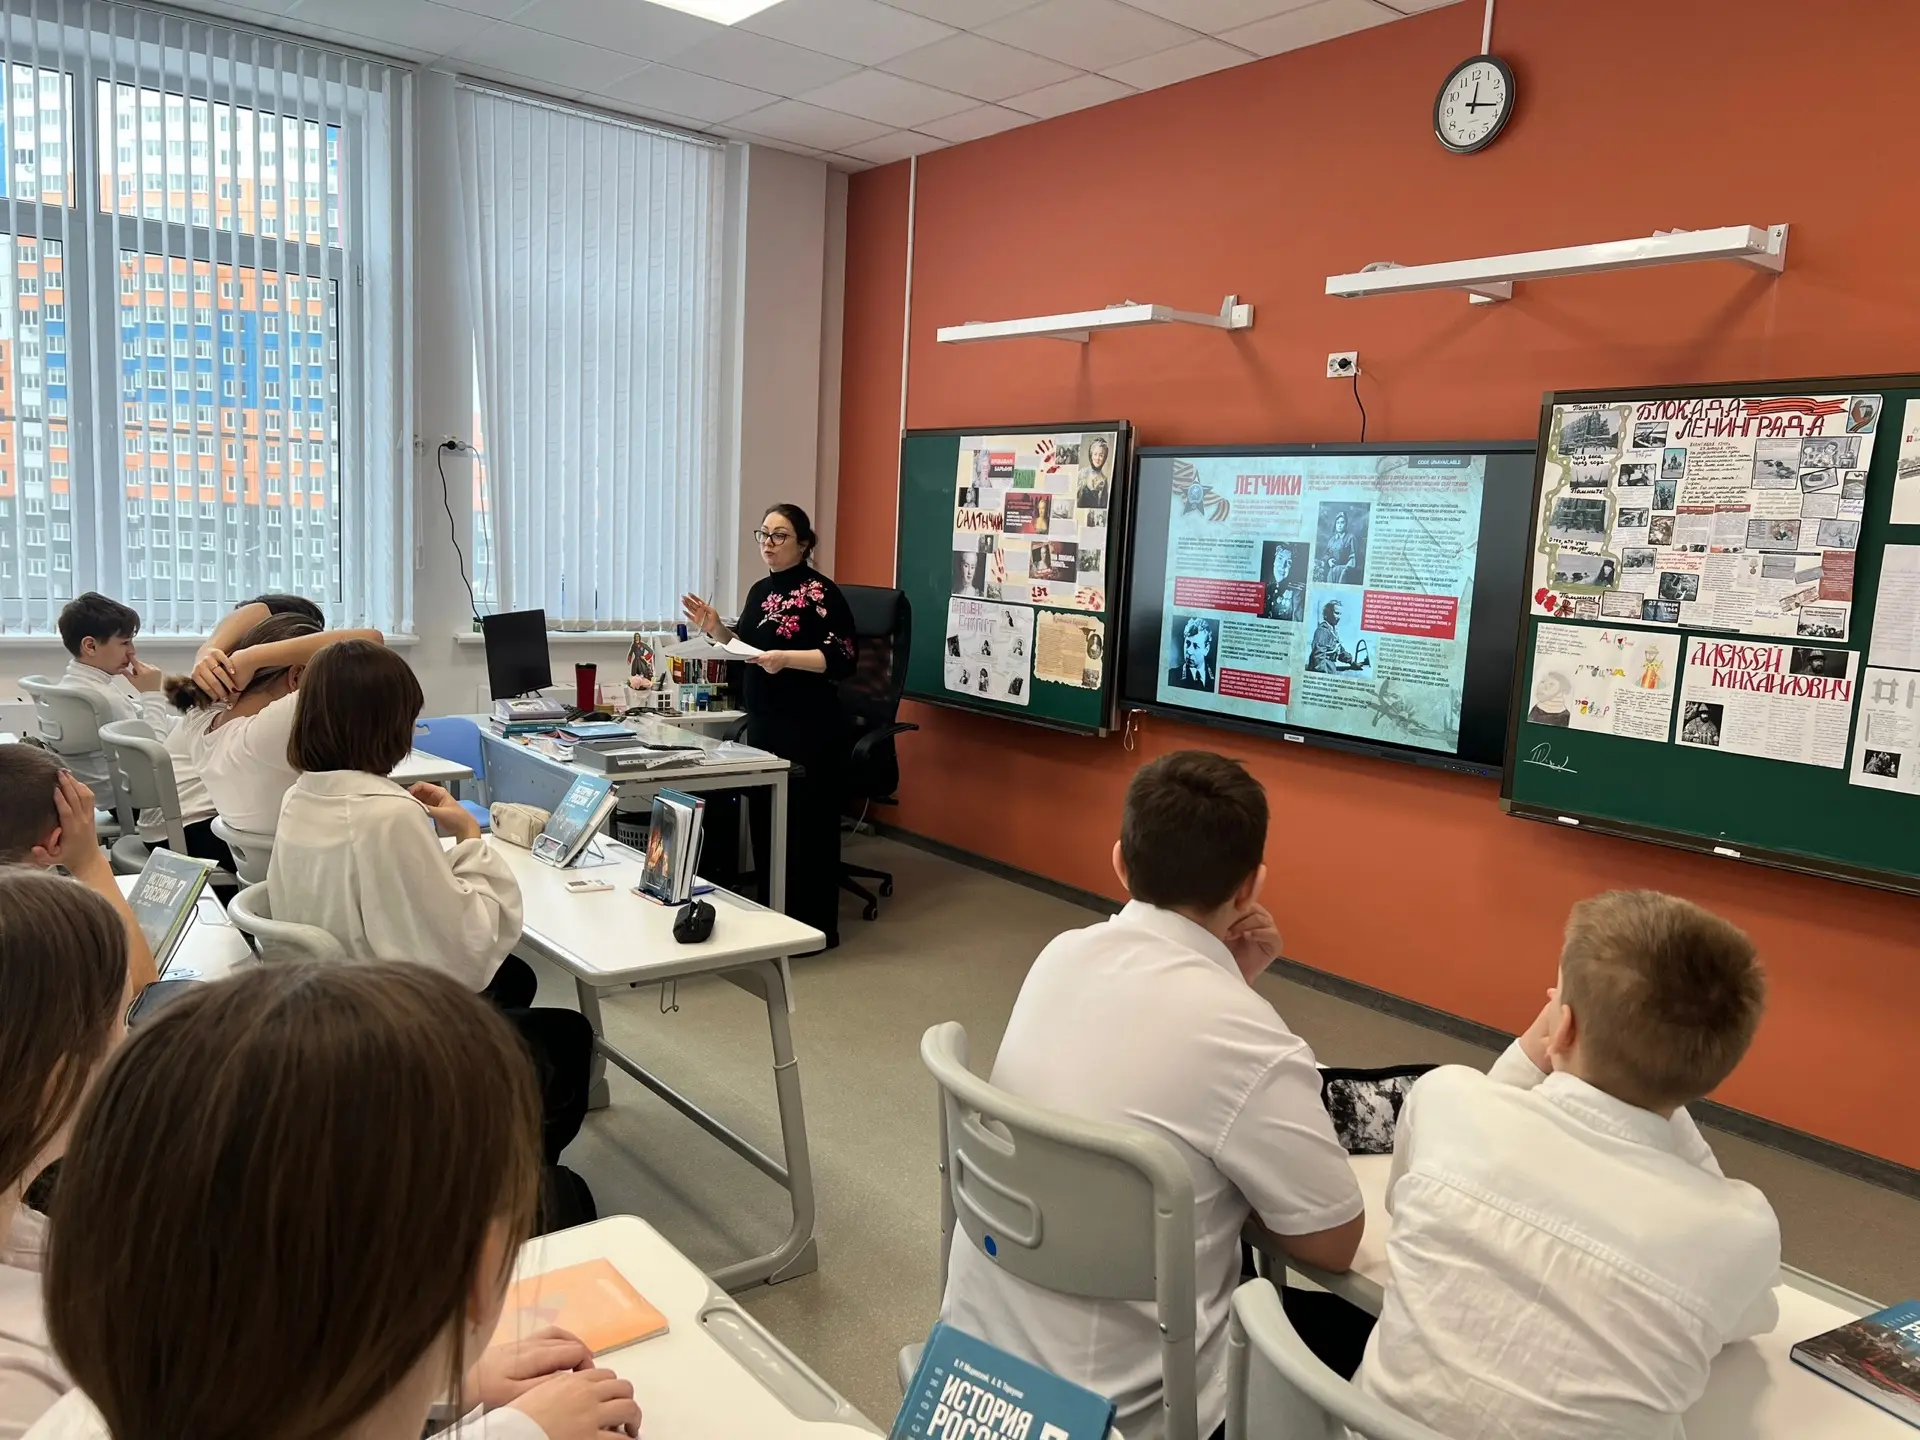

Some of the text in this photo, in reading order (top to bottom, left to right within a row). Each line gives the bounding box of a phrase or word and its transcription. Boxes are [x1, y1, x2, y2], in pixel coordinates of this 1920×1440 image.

[1472, 70, 1482, 81] 12
[1460, 78, 1468, 89] 11
[1493, 79, 1500, 90] 2
[1448, 92, 1460, 102] 10
[1496, 92, 1504, 104] 3
[1446, 106, 1454, 117] 9
[1448, 121, 1456, 130] 8
[1482, 122, 1489, 134] 5
[1458, 129, 1465, 139] 7
[1468, 130, 1476, 140] 6
[1636, 397, 1741, 421] БЛОКАДА
[1675, 414, 1825, 439] ЛЕНИНГРАДА
[1234, 474, 1302, 495] ЛЕТЧИКИ
[1690, 642, 1784, 673] АЛЕКСЕЙ
[140, 884, 171, 904] РОССИИ
[147, 872, 187, 907] ИСТОРИЯ 7
[940, 1373, 1033, 1440] ИСТОРИЯ
